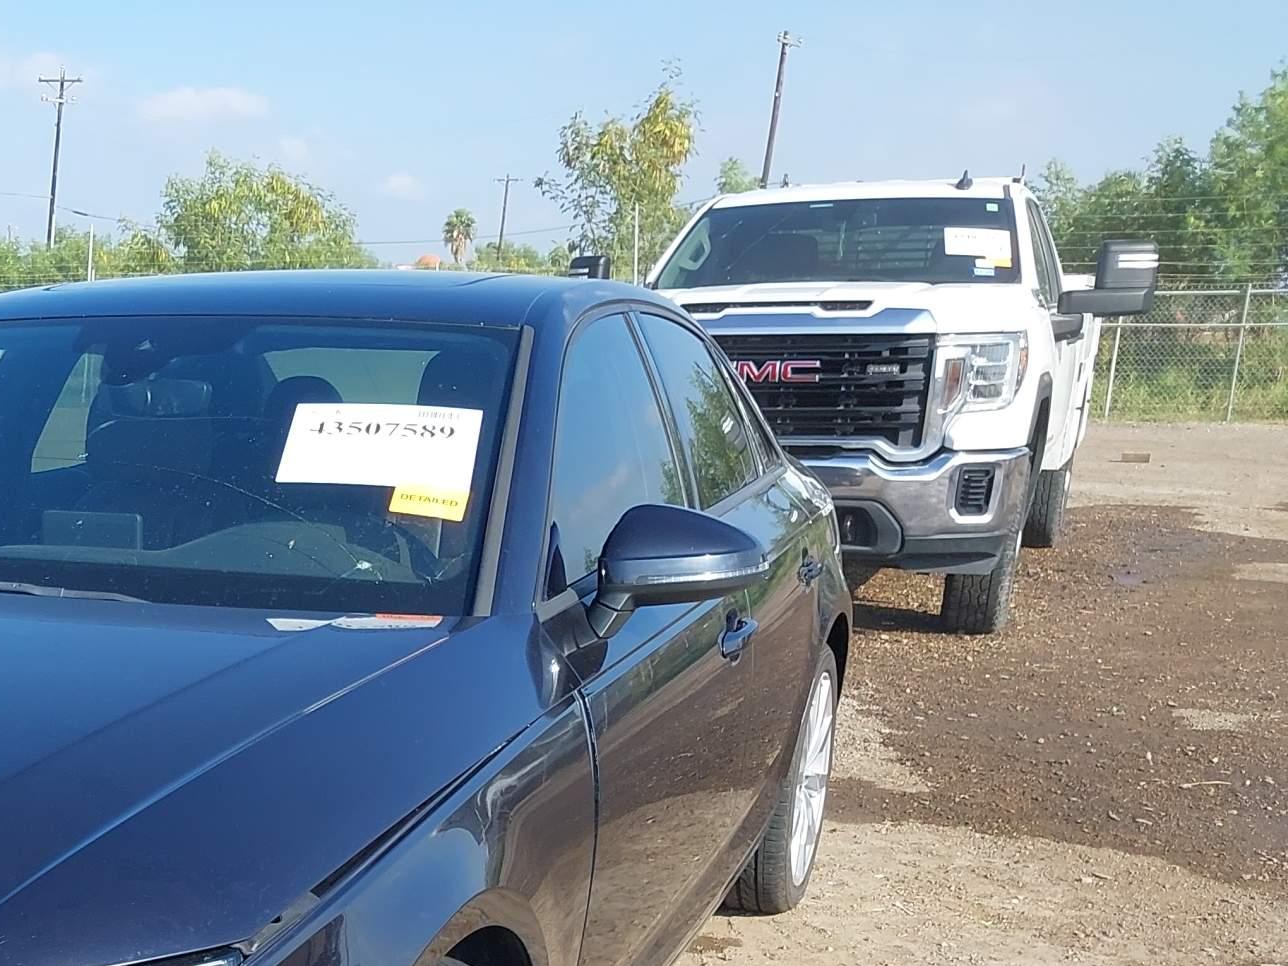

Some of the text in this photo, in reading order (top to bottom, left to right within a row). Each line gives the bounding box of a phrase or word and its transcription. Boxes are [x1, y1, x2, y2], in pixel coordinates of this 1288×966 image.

[732, 359, 821, 383] MC
[309, 420, 456, 439] 43507589
[399, 493, 459, 507] DETAILED
